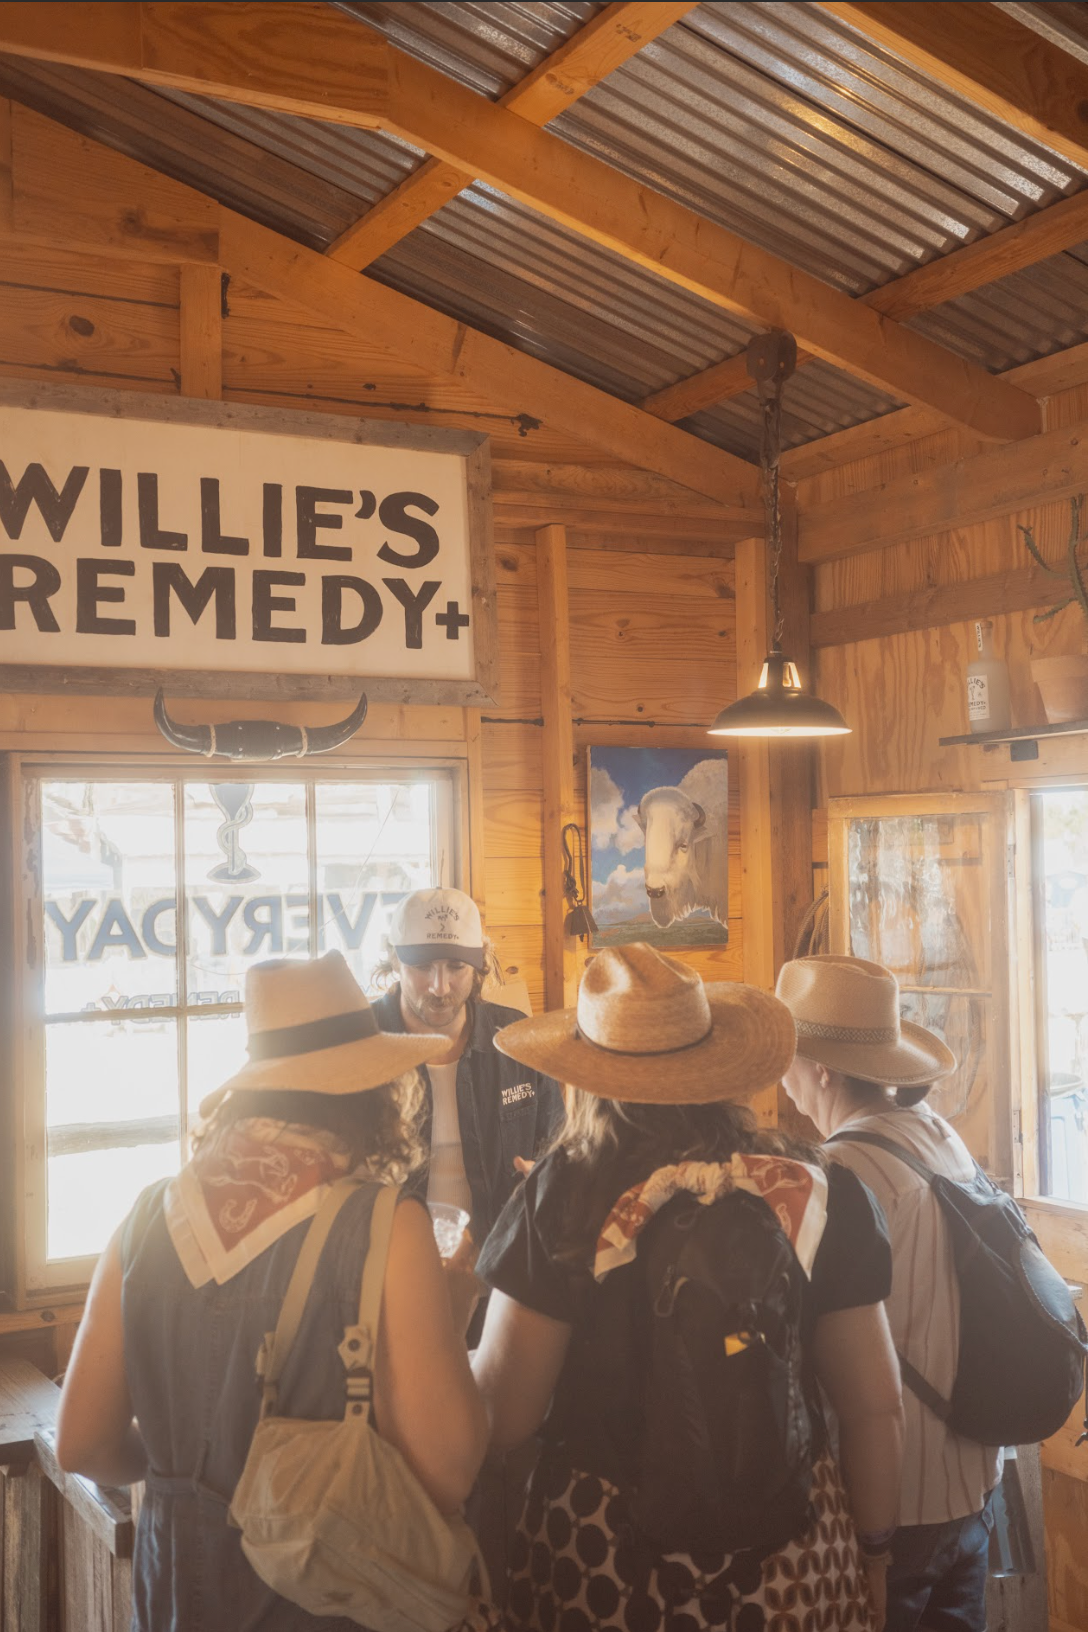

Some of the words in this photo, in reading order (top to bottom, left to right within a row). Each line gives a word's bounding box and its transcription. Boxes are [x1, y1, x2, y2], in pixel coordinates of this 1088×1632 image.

[0, 459, 440, 569] WILLIE'S
[0, 554, 470, 650] REMEDY+
[425, 905, 460, 921] WILLIE'S
[501, 1082, 532, 1098] WILLIE'S
[502, 1089, 536, 1106] REMEDY+
